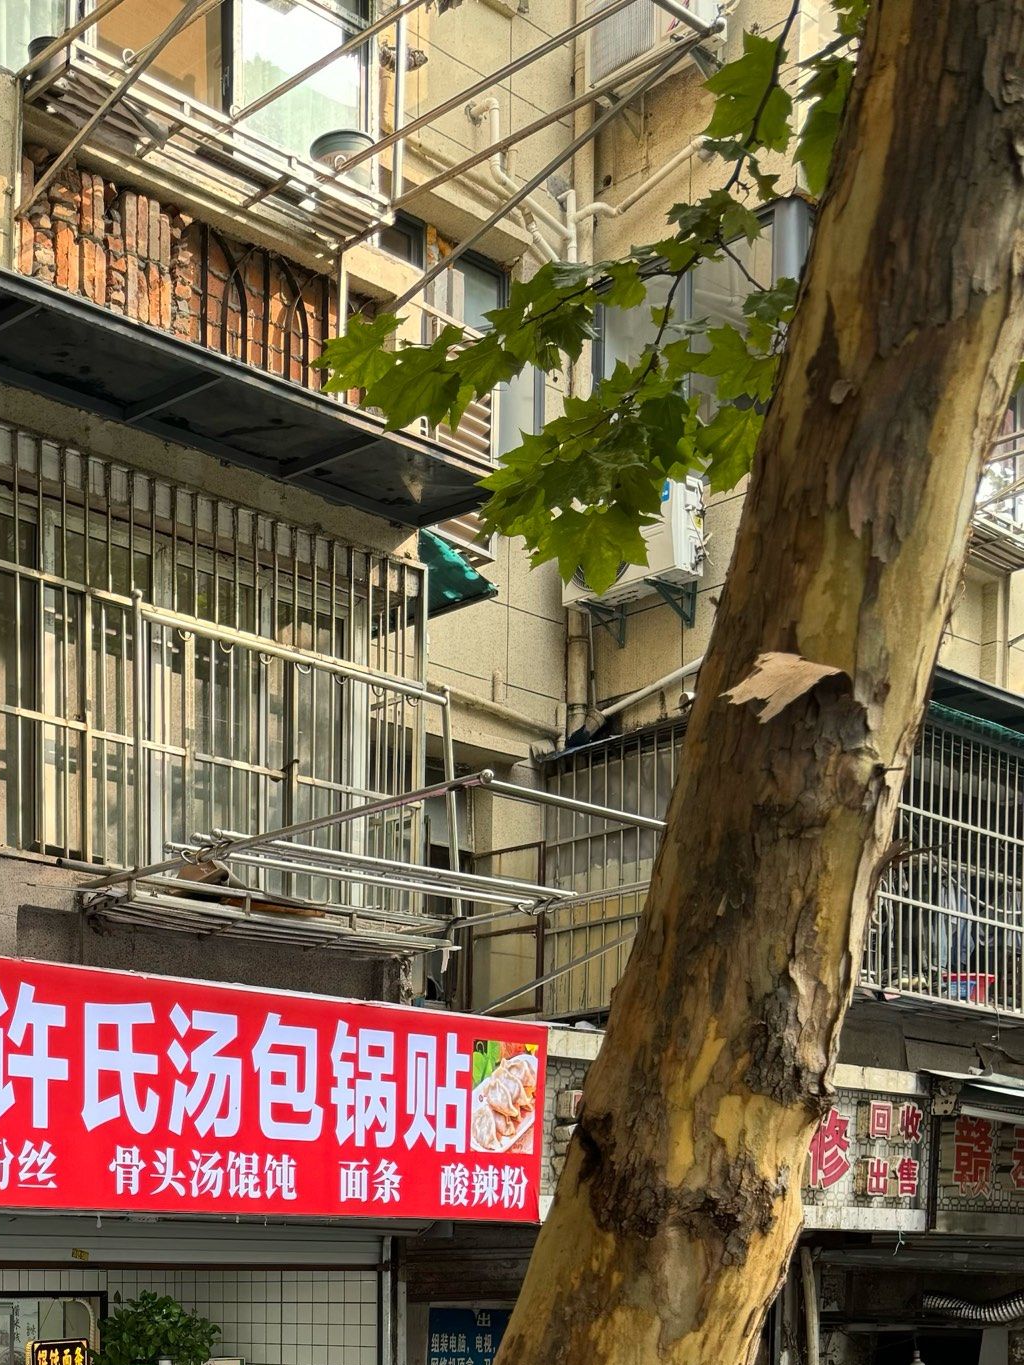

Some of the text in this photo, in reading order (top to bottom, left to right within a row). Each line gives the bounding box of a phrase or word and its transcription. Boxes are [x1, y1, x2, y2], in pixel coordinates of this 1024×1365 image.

[869, 1100, 923, 1144] 回收
[109, 1147, 298, 1203] 骨头汤馄饨
[338, 1159, 402, 1204] 面条
[439, 1163, 529, 1210] 酸辣粉
[867, 1157, 919, 1197] 出售
